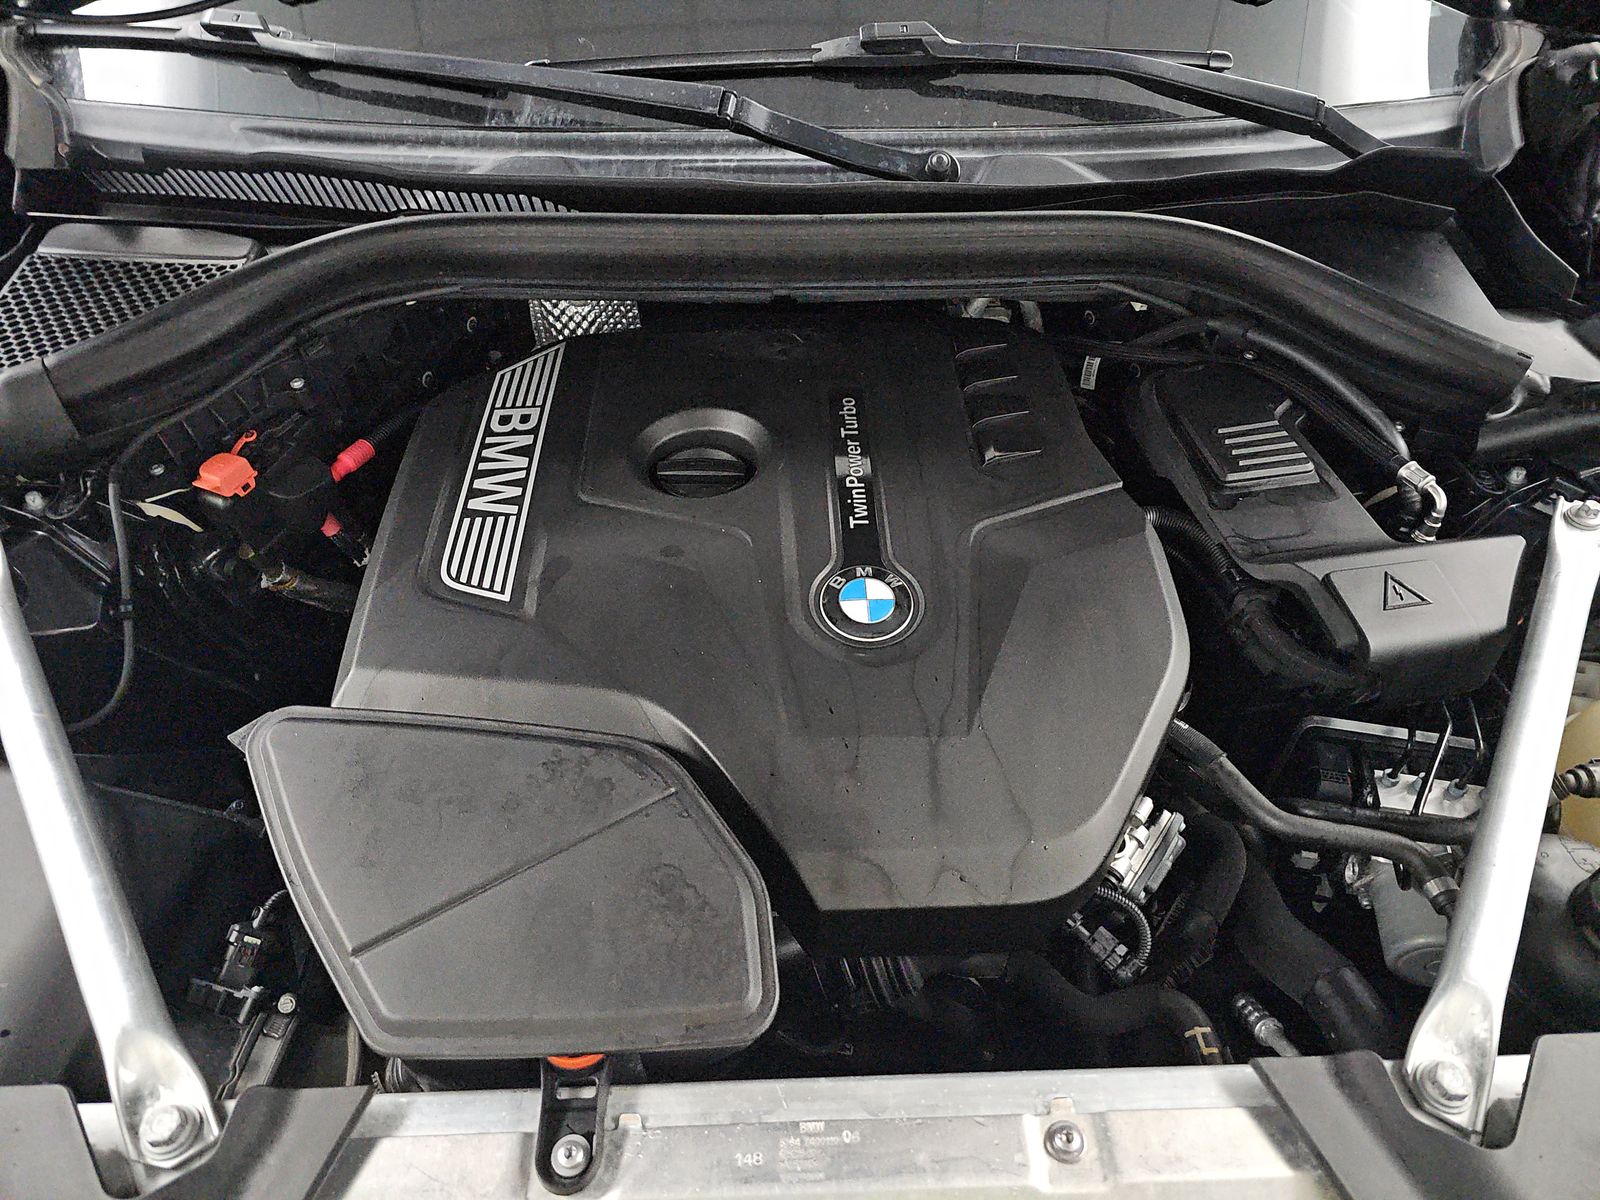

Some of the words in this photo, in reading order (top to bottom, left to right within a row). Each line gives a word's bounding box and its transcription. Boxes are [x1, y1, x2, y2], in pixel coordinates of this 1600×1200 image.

[839, 397, 859, 438] Turbo
[466, 407, 541, 515] BMW
[829, 566, 903, 590] BMW
[735, 1151, 763, 1168] 148
